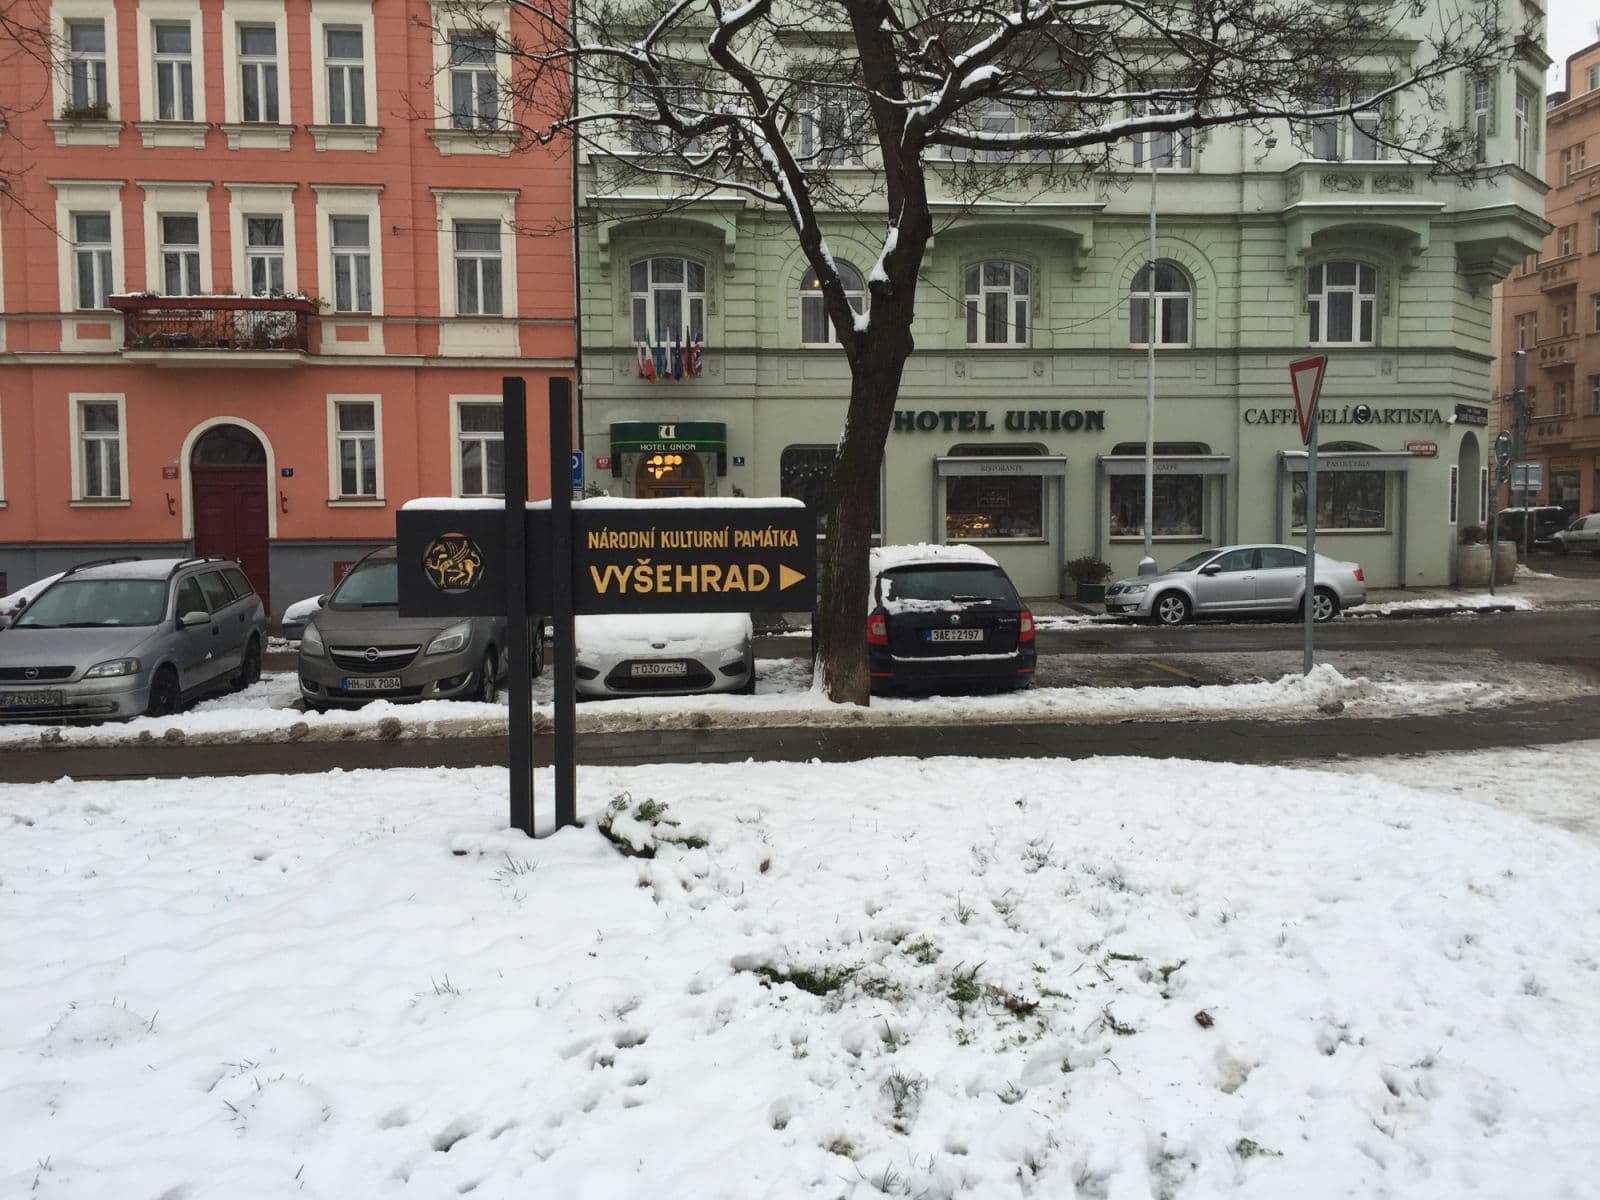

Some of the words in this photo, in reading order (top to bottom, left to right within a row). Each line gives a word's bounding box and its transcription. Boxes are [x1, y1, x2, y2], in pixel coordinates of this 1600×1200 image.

[893, 410, 995, 431] HOTEL
[1004, 409, 1105, 431] UNION
[1369, 407, 1443, 424] ARTISTA
[670, 443, 697, 451] UNION
[588, 527, 655, 549] NÁRODNÍ
[660, 525, 729, 548] KULTURNÍ
[734, 525, 799, 547] PAMÁTKA
[589, 558, 770, 593] VYŠEHRAD
